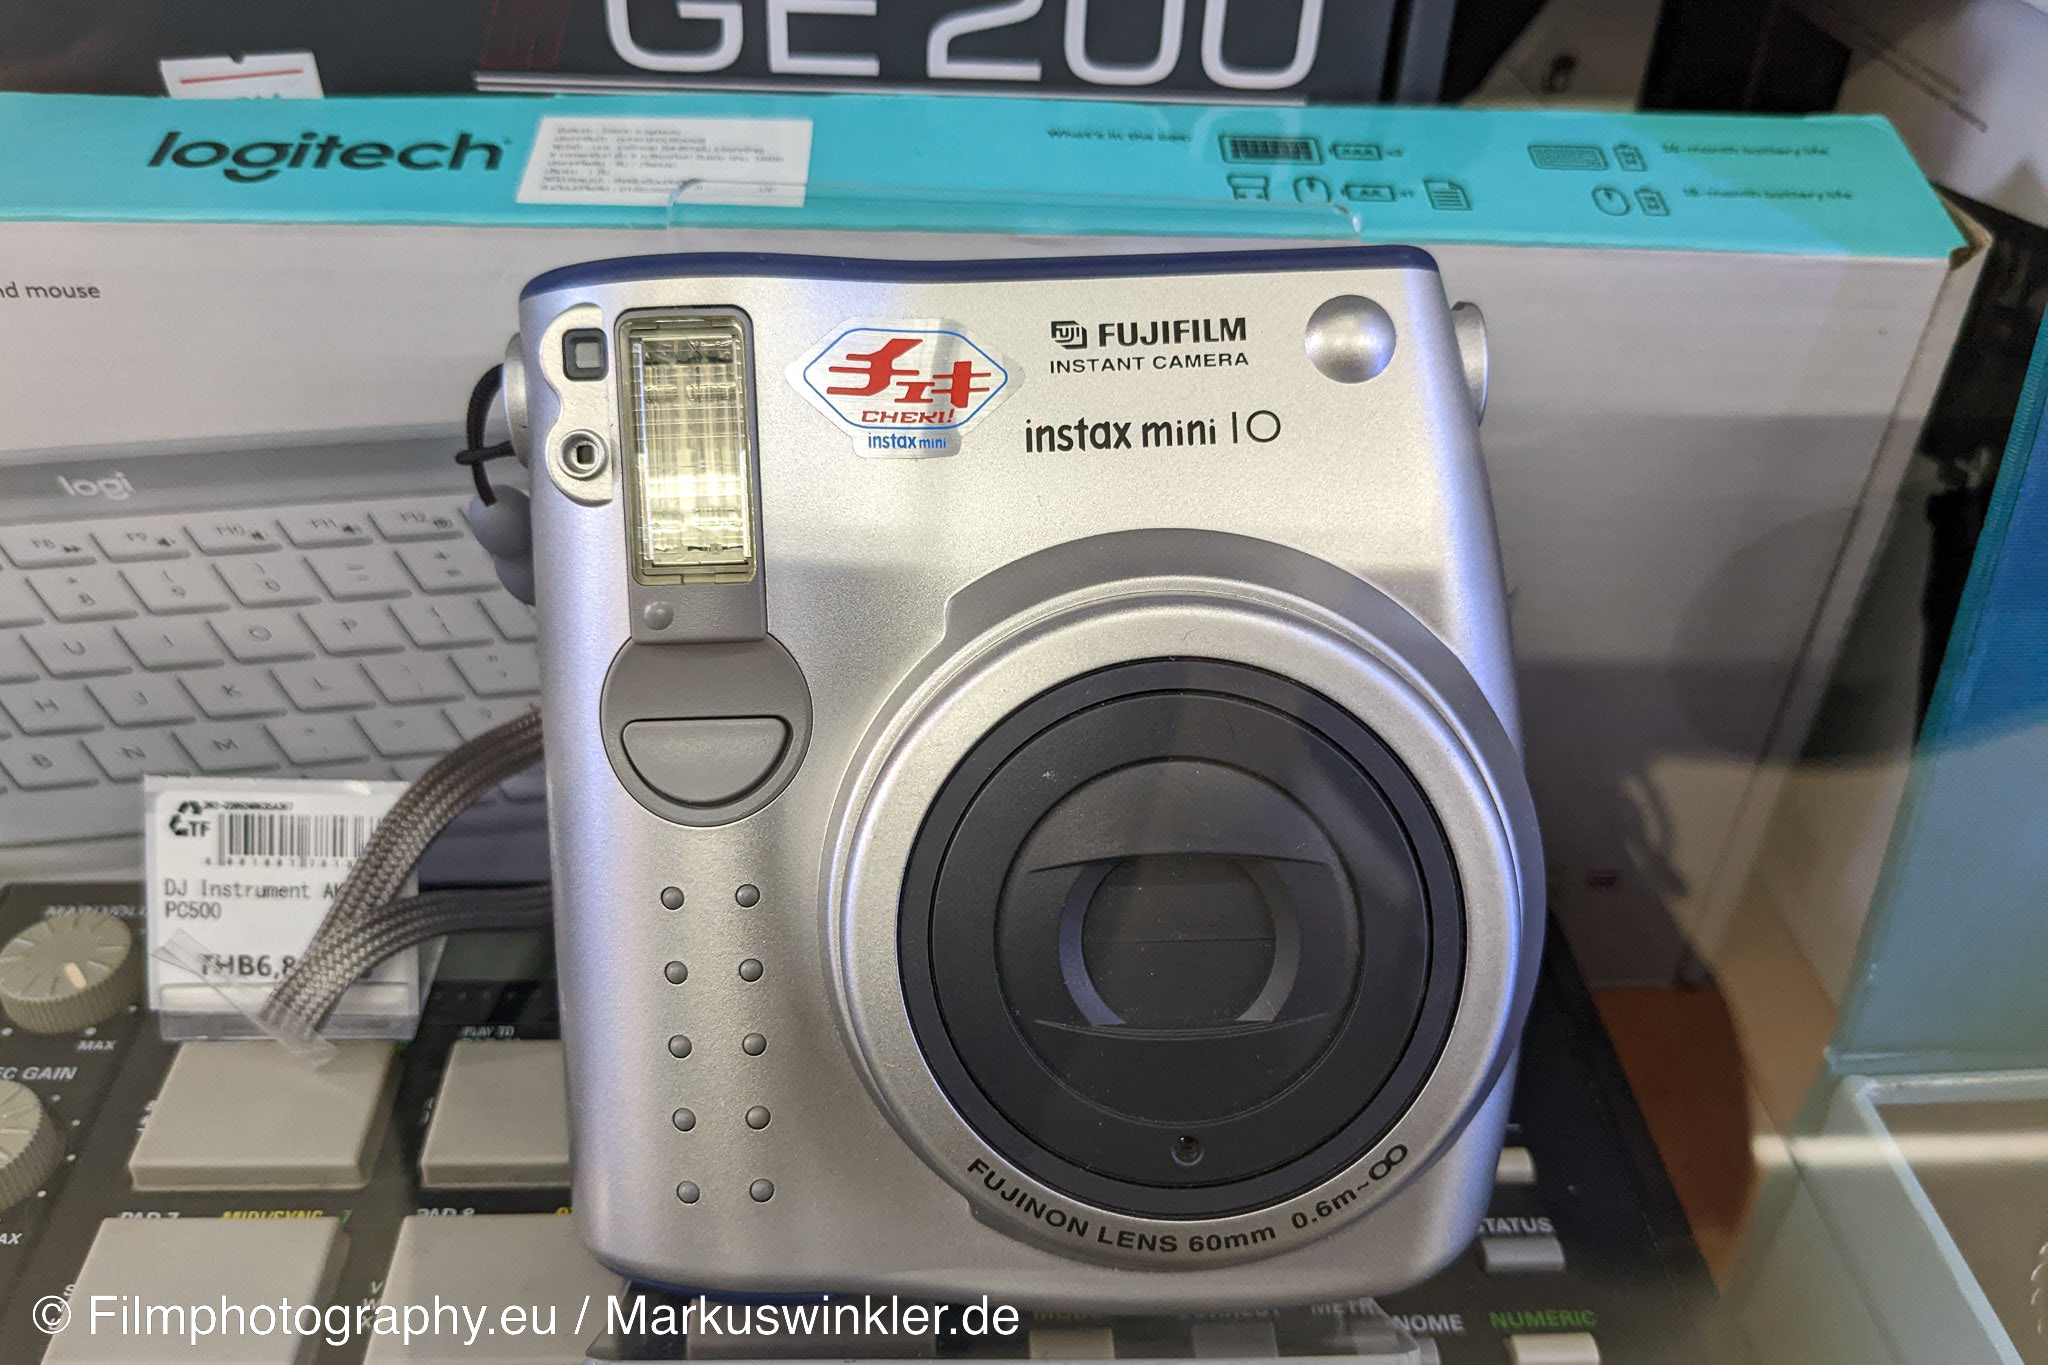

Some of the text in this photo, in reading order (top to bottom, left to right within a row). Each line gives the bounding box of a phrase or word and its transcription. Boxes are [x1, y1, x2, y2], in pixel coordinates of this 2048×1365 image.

[147, 131, 504, 184] logitech
[25, 285, 101, 299] mouse
[1098, 317, 1248, 348] FUJIFILM
[1050, 352, 1250, 375] INSTANT CAMERA
[861, 409, 955, 424] CHEKI!
[868, 431, 947, 449] instax mini
[1024, 409, 1282, 454] instax mini 10
[57, 471, 136, 501] logi
[164, 878, 188, 897] DJ
[201, 879, 311, 899] Instrument
[165, 901, 223, 919] PC500
[22, 1065, 78, 1081] GAIN
[967, 1158, 1089, 1237] FUJINON
[1097, 1226, 1178, 1252] LENS
[1188, 1225, 1277, 1252] 60mm
[1488, 1308, 1597, 1330] NUMERIC
